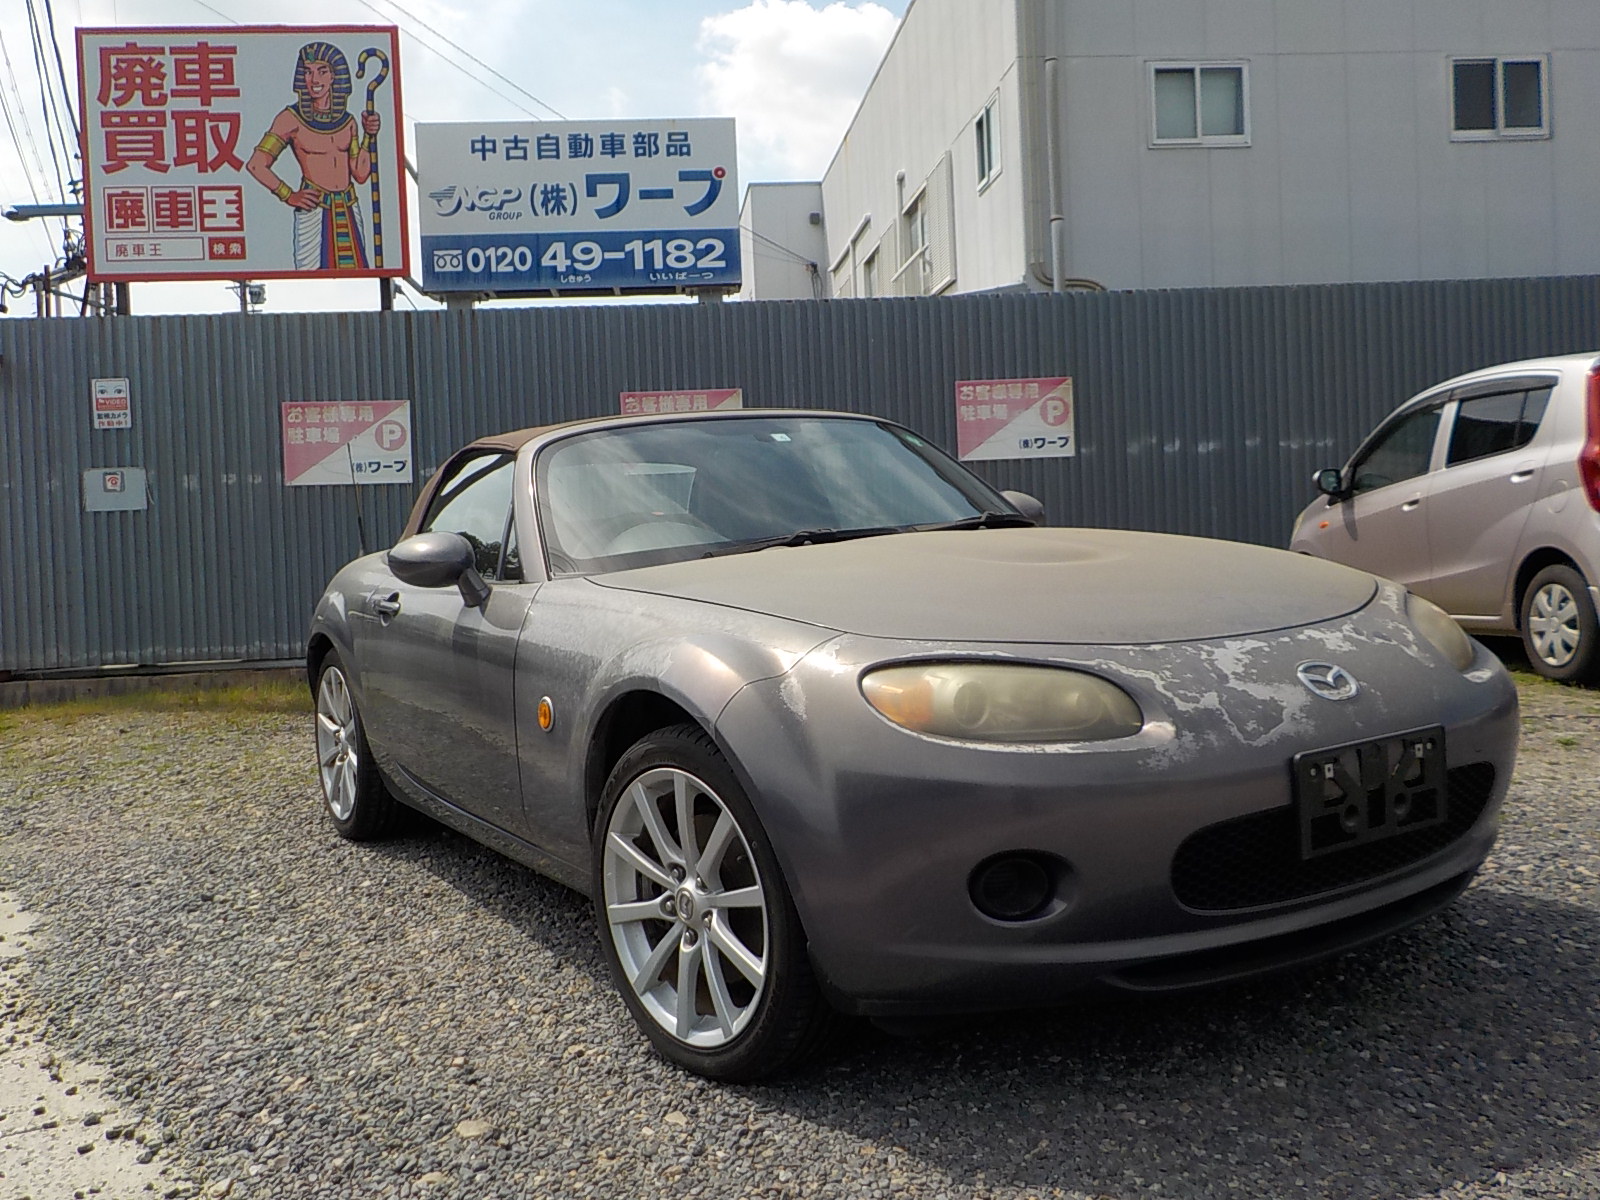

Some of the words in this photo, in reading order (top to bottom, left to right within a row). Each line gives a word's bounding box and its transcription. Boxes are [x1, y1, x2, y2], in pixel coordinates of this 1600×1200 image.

[97, 42, 241, 107] 廃車
[100, 109, 244, 175] 買取
[470, 131, 692, 162] 中古自動車部品
[104, 186, 244, 233] 廃車王
[489, 211, 523, 221] GROUP
[115, 243, 162, 257] 廃車王
[212, 242, 242, 256] 検索
[466, 246, 533, 273] 0120
[541, 237, 727, 273] 49-1182
[1047, 401, 1065, 423] P
[382, 424, 402, 449] P
